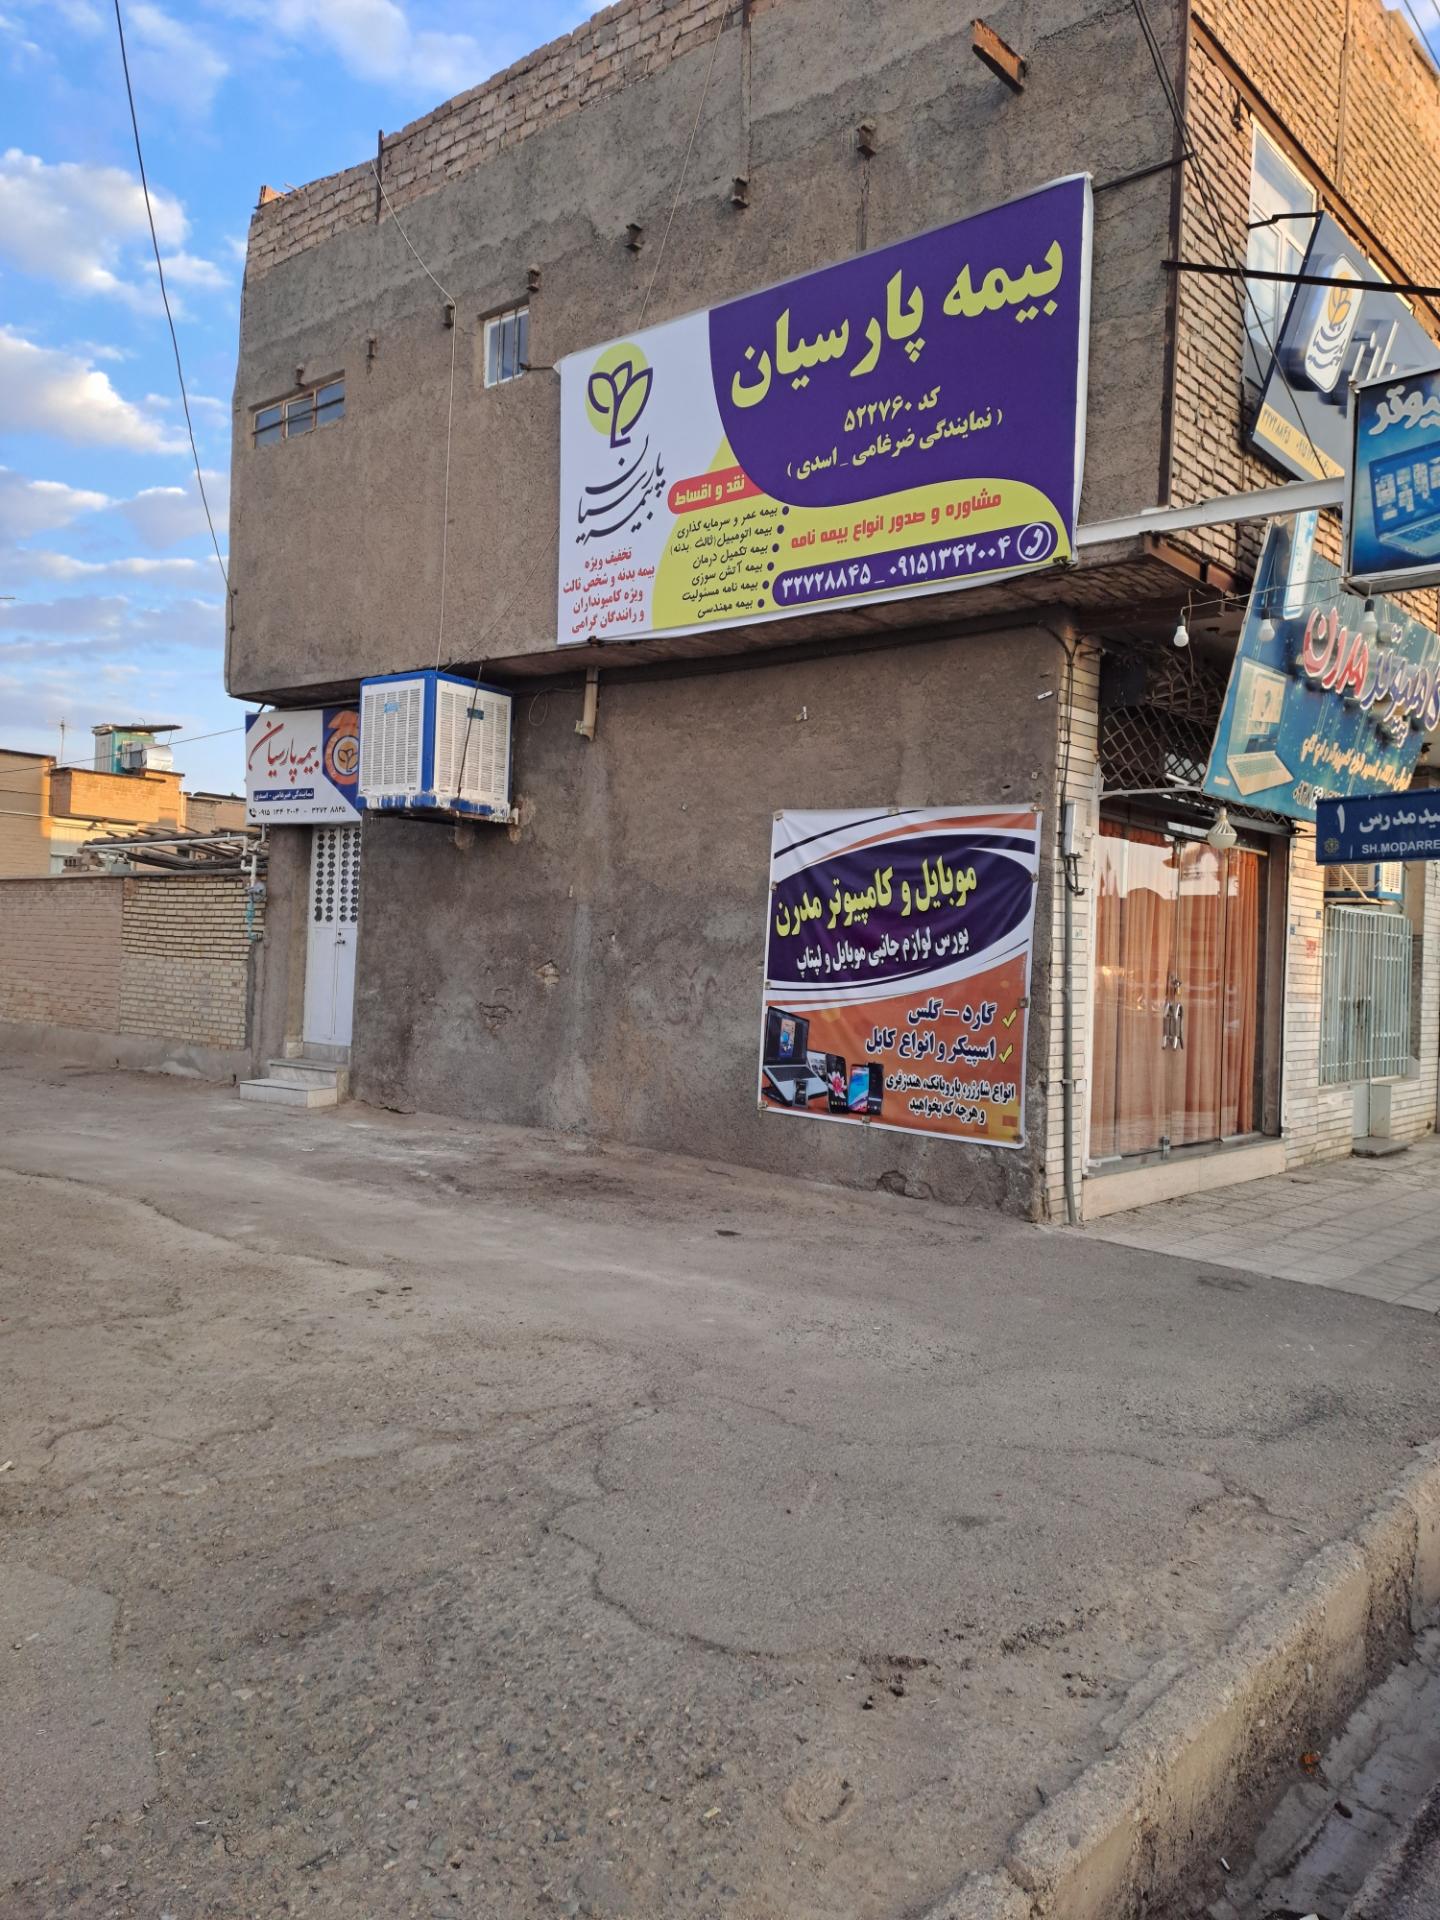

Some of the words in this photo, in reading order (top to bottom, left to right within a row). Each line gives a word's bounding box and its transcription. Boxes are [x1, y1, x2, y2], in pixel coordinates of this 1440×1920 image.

[943, 239, 1063, 323] بیمه
[731, 269, 926, 408] پارسیان
[918, 385, 941, 411] کد
[843, 395, 912, 432] ۵۲۲۷۶۰
[919, 407, 992, 449] نمایندگی
[852, 428, 915, 466] ضرغامی
[797, 447, 837, 480] اسدی
[715, 483, 722, 500] و
[727, 473, 745, 494] نقد
[674, 483, 711, 506] اقساط
[946, 488, 1002, 521] مشاوره
[733, 517, 738, 527] و
[742, 511, 756, 525] عمر
[760, 506, 778, 517] بیمه
[931, 507, 940, 524] و
[754, 525, 772, 537] بیمه
[853, 515, 884, 541] انواع
[888, 511, 926, 535] صدور
[791, 530, 815, 549] نامه
[821, 526, 848, 544] بیمه
[605, 547, 632, 565] تخفیف
[692, 551, 717, 568] درمان
[720, 546, 747, 564] تکمیل
[750, 544, 768, 555] بیمه
[889, 535, 1012, 577] ۰۹۱۵۱۳۴۲۰۰۴
[585, 556, 603, 572] ویژه
[637, 566, 655, 578] بیمه
[719, 560, 742, 581] آتش
[745, 562, 763, 573] بیمه
[563, 577, 581, 593] ثالث
[583, 573, 608, 592] شخص
[610, 576, 615, 587] و
[618, 568, 635, 582] بدنه
[691, 572, 716, 586] سوزی
[740, 580, 758, 591] بیمه
[782, 563, 871, 599] ۳۲۷۲۸۸۴۵
[624, 588, 643, 604] ویژه
[723, 583, 737, 593] نامه
[573, 589, 622, 614] کامیونداران
[697, 604, 733, 618] مهندسی
[735, 599, 753, 609] بیمه
[572, 614, 597, 634] گرامی
[600, 607, 637, 628] رانندگان
[639, 609, 644, 621] و
[248, 721, 297, 784] پارسیان
[297, 745, 320, 774] بیمه
[1360, 810, 1416, 833] مدرس
[1361, 840, 1440, 854] SH.MODARRE
[916, 856, 977, 912] موبایل
[827, 866, 893, 929] کامپیوتر
[900, 880, 911, 916] و
[776, 892, 822, 937] مدرن
[868, 933, 900, 967] جانبی
[902, 926, 931, 962] لوازم
[935, 927, 969, 955] بورس
[825, 954, 831, 973] و
[832, 939, 866, 972] موبایل
[908, 998, 943, 1024] گلس
[962, 1001, 996, 1030] گارد
[866, 1026, 896, 1053] کابل
[899, 1031, 934, 1058] انواع
[949, 1035, 996, 1065] اسپیکر
[936, 1042, 945, 1061] و
[992, 1083, 1015, 1104] انواع
[909, 1098, 942, 1117] بخواهید
[979, 1109, 985, 1125] و
